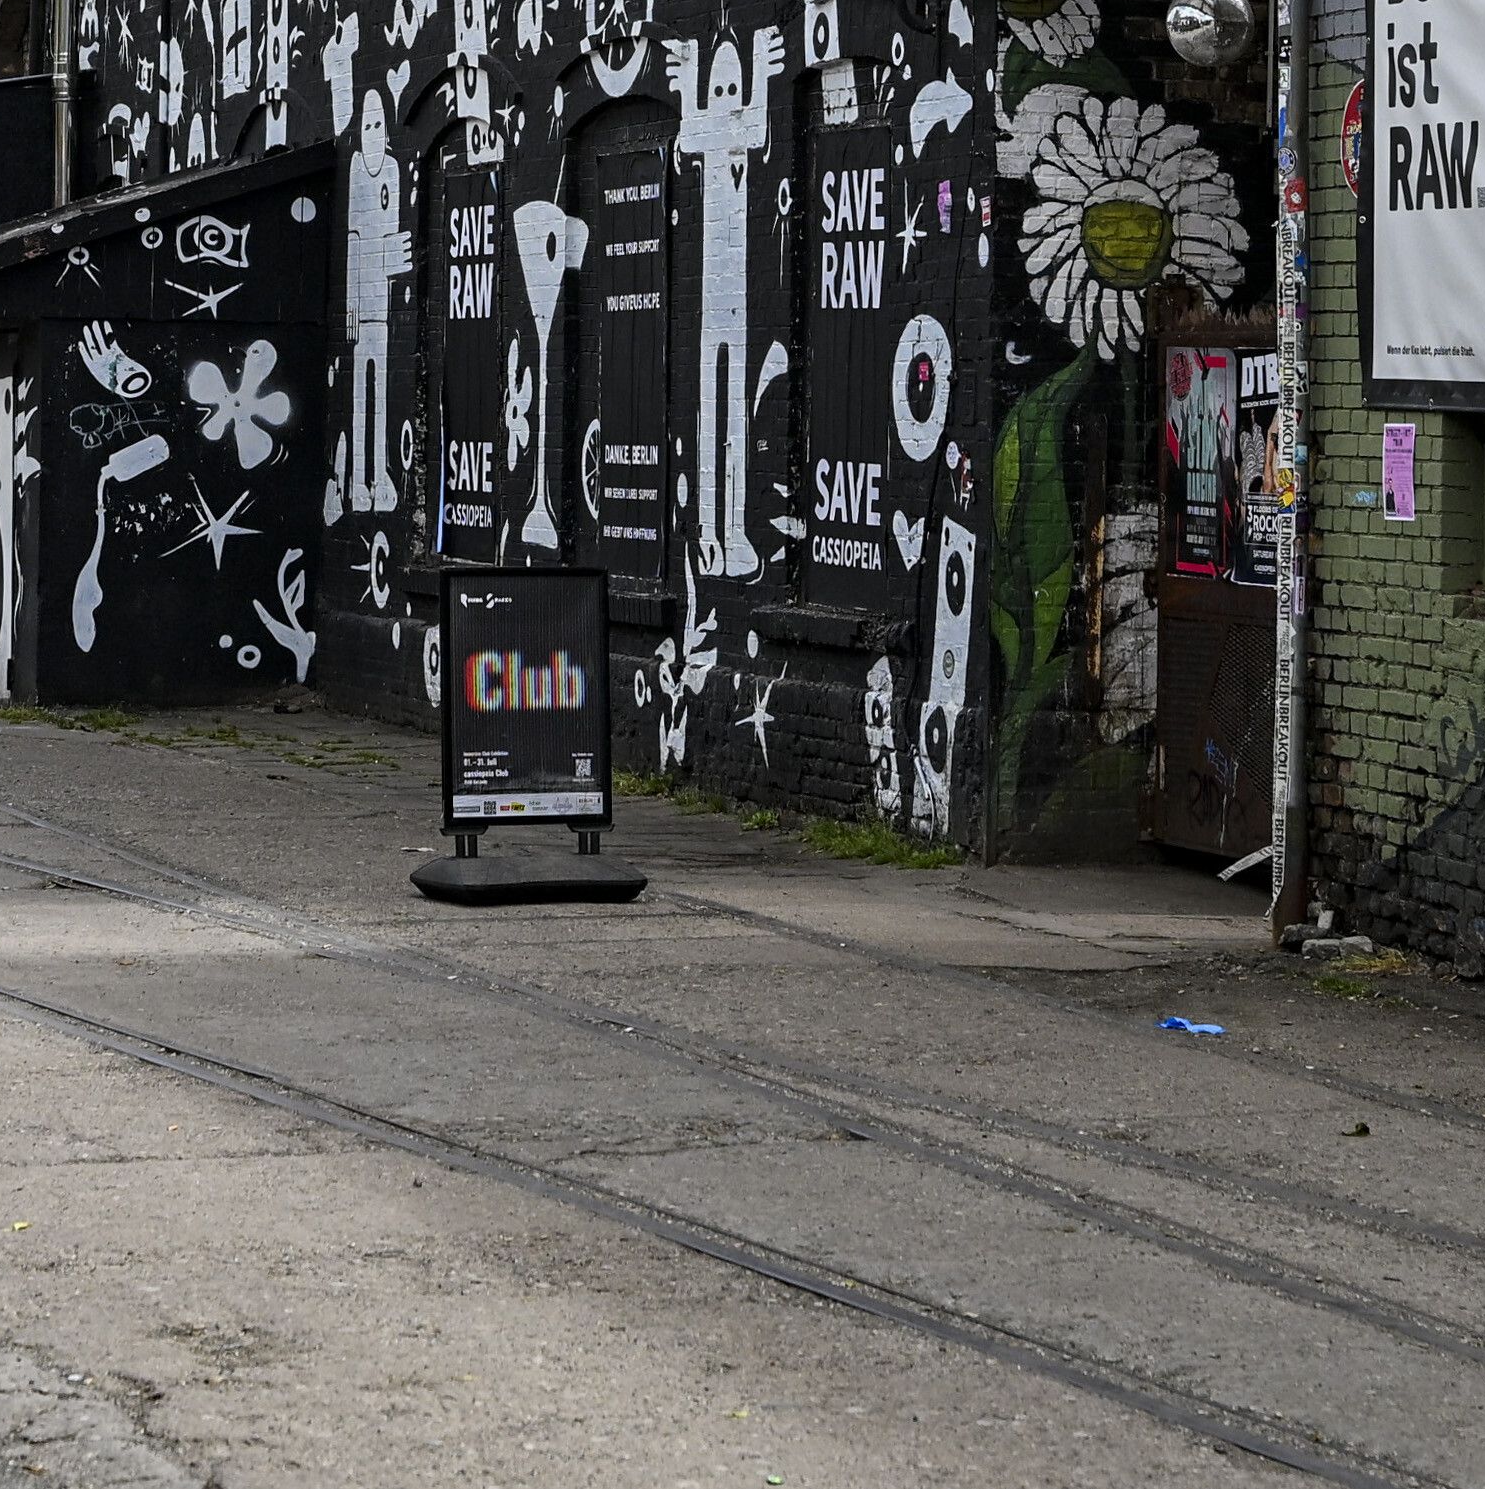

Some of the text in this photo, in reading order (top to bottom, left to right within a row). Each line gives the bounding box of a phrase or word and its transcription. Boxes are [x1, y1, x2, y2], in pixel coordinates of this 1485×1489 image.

[1388, 21, 1439, 108] ist
[604, 188, 625, 204] THANK
[640, 183, 660, 200] BERLIN
[822, 168, 885, 233] SAVE
[450, 205, 495, 258] SAVE
[449, 263, 494, 319] RAW
[821, 240, 884, 309] RAW
[447, 440, 493, 492] SAVE
[632, 445, 658, 465] BERLIN
[443, 502, 493, 527] CASSIOPEIA
[815, 458, 882, 526] SAVE
[813, 535, 882, 570] CASSIOPEIA
[465, 649, 587, 711] Club
[1277, 659, 1290, 783] BERLINBREAKOUT
